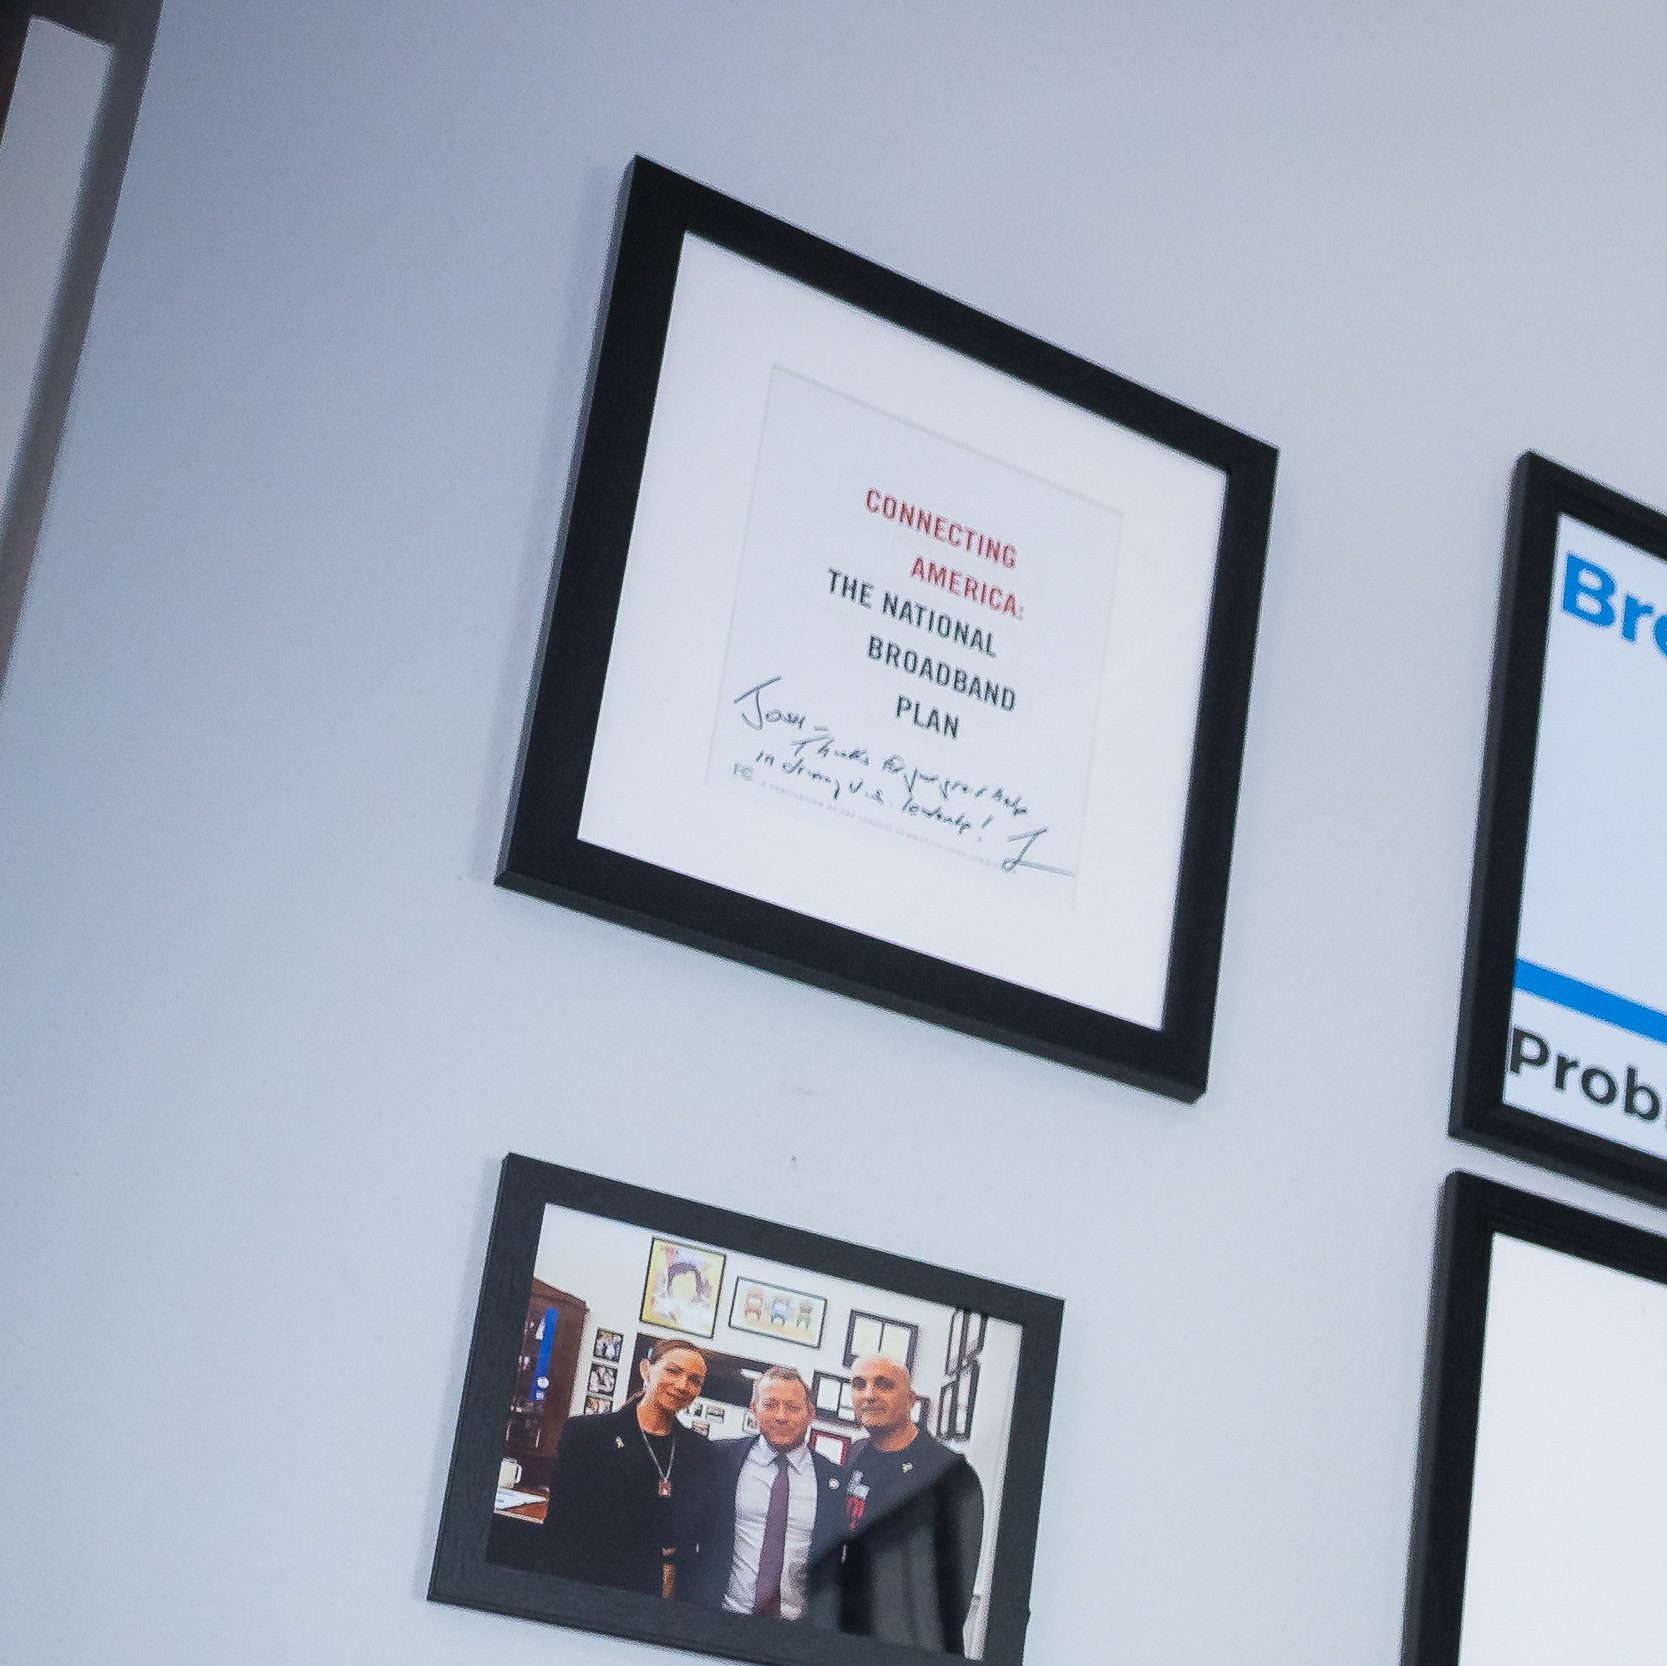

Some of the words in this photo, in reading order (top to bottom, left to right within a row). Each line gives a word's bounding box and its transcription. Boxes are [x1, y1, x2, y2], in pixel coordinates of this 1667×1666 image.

[865, 487, 1017, 569] CONNECTING
[827, 568, 873, 609] THE
[882, 591, 998, 658] NATIONAL
[911, 555, 1025, 620] AMERICA:
[867, 634, 1017, 712] BROADBAND
[895, 695, 960, 740] PLAN
